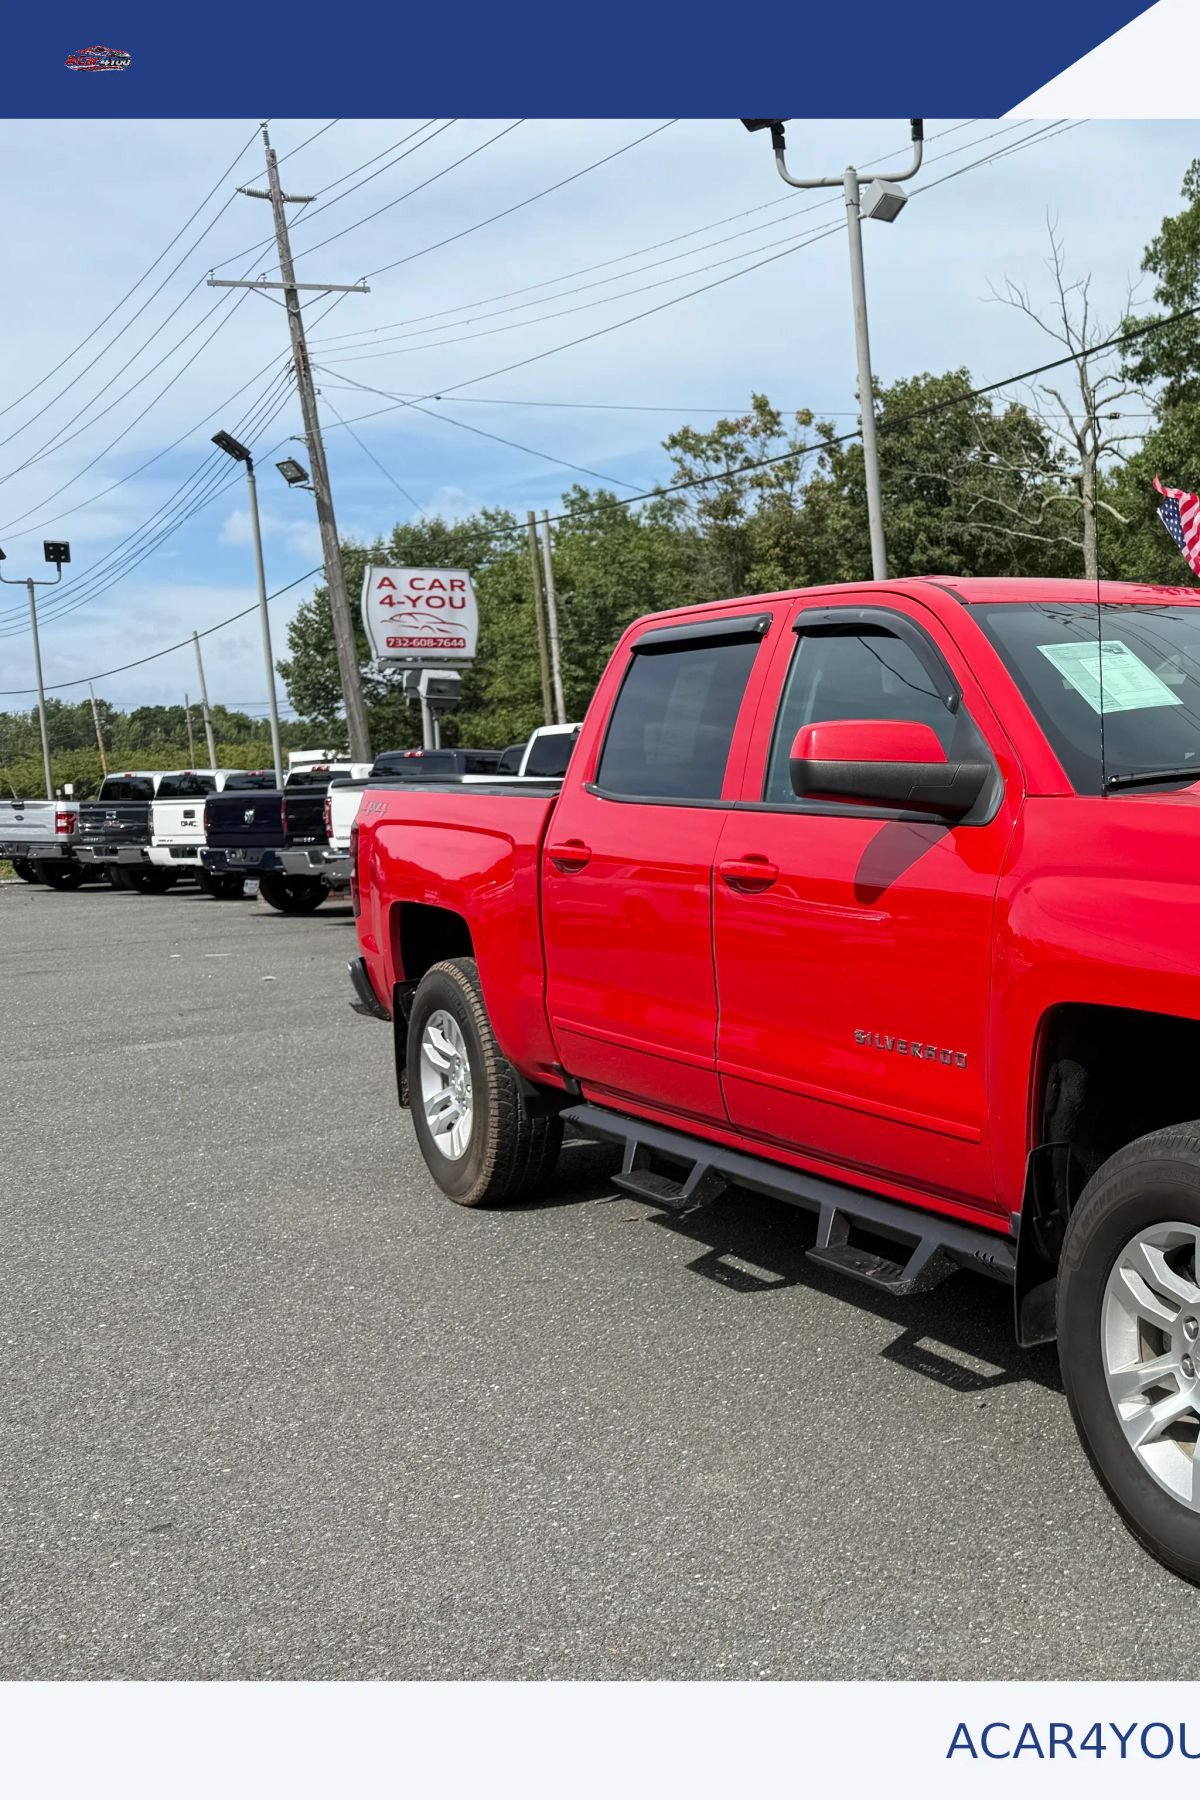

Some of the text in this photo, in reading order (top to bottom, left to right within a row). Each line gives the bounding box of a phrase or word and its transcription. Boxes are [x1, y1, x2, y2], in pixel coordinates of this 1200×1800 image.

[376, 576, 466, 592] A CAR
[379, 594, 466, 609] 4-YOU
[387, 638, 465, 648] 732-608-7644
[853, 1028, 968, 1069] SILVERADO
